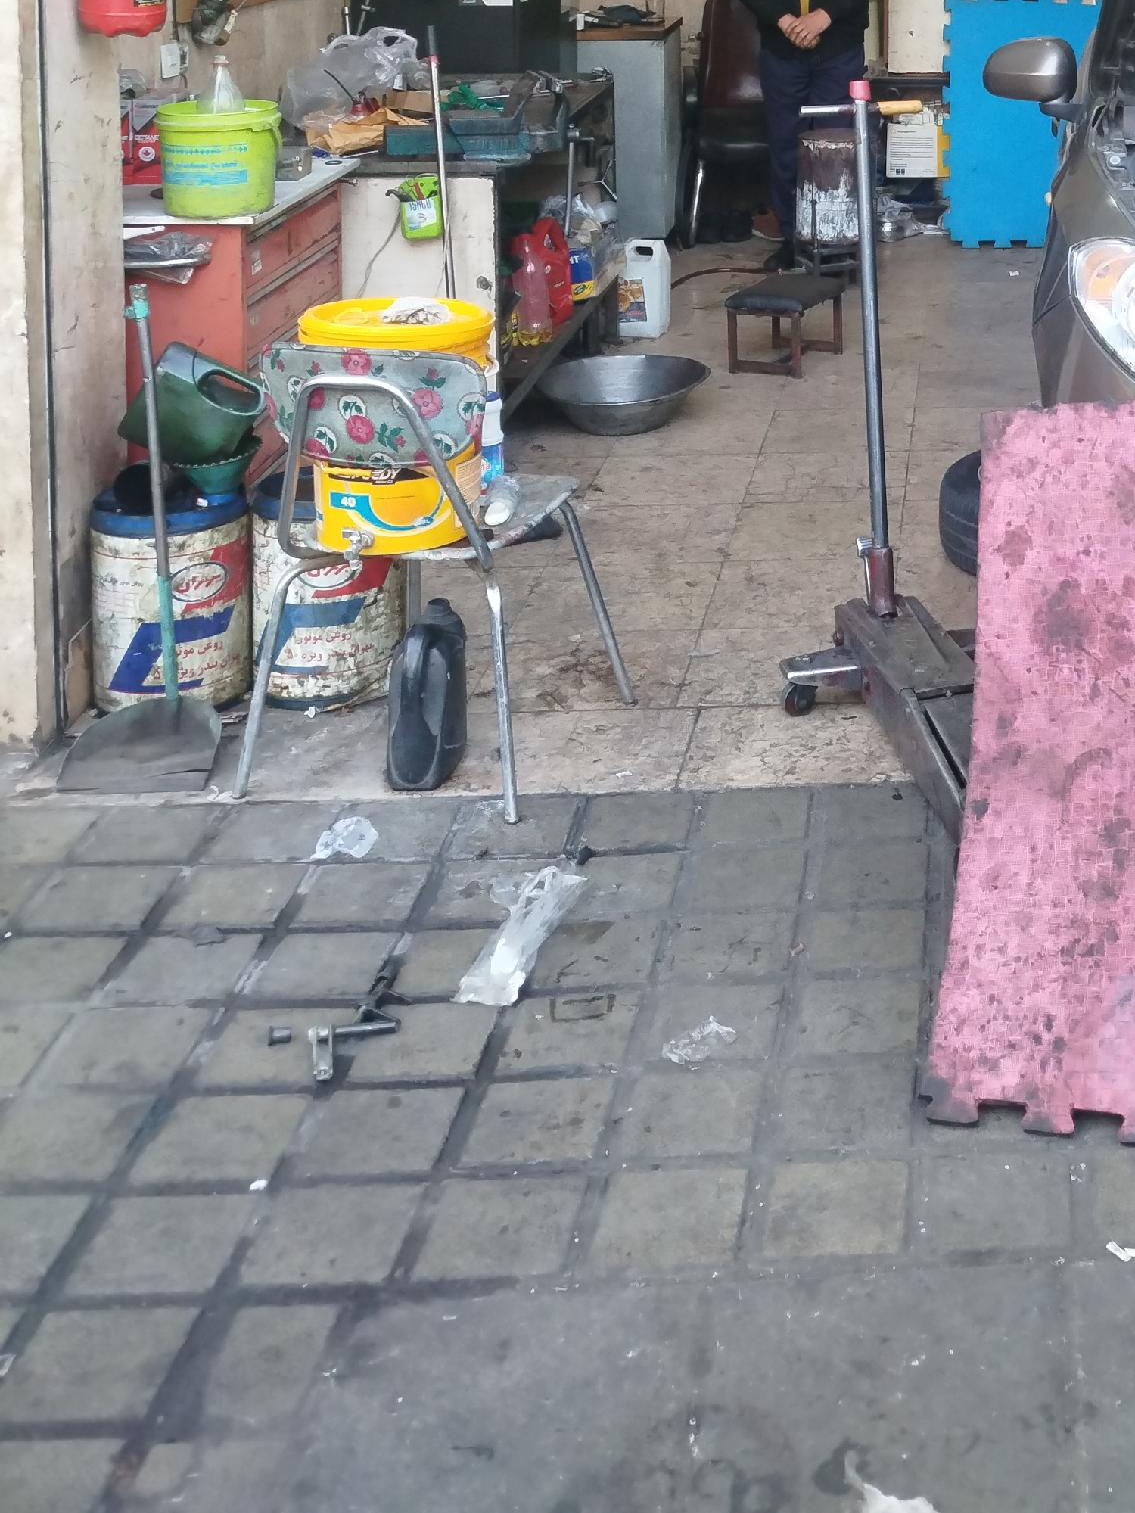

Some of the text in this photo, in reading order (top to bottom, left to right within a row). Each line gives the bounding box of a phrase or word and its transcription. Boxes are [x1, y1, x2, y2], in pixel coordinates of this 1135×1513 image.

[340, 496, 357, 507] 40
[325, 631, 352, 643] روغن
[197, 641, 224, 656] روغن
